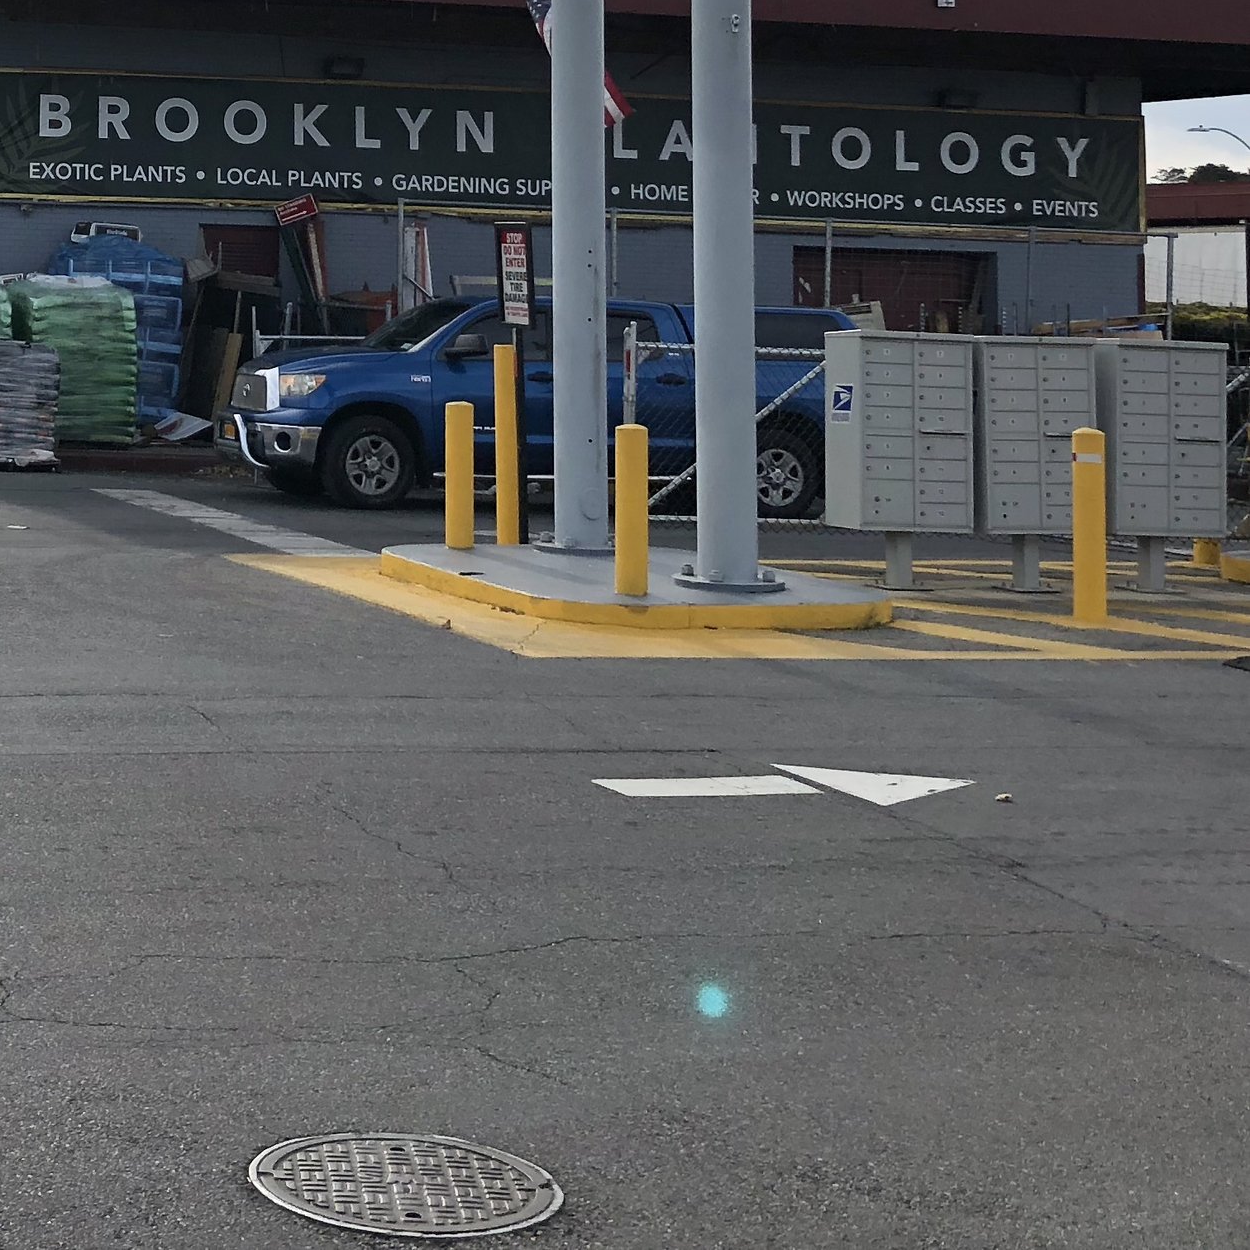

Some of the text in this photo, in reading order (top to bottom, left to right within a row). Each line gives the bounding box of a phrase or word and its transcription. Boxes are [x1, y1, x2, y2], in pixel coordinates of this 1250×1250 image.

[38, 93, 1090, 178] BROOKLYN LATOLOGY
[29, 161, 1100, 219] EXOTIC PLANTS LOCAL PLANTS GARDENING SUP HOME WORKSHOPS CLASSES EVENTS
[506, 233, 523, 244] STOP
[503, 245, 526, 256] DO NOT
[505, 258, 525, 268] ENTER
[505, 271, 528, 281] SEVERE
[510, 282, 524, 292] TIRE
